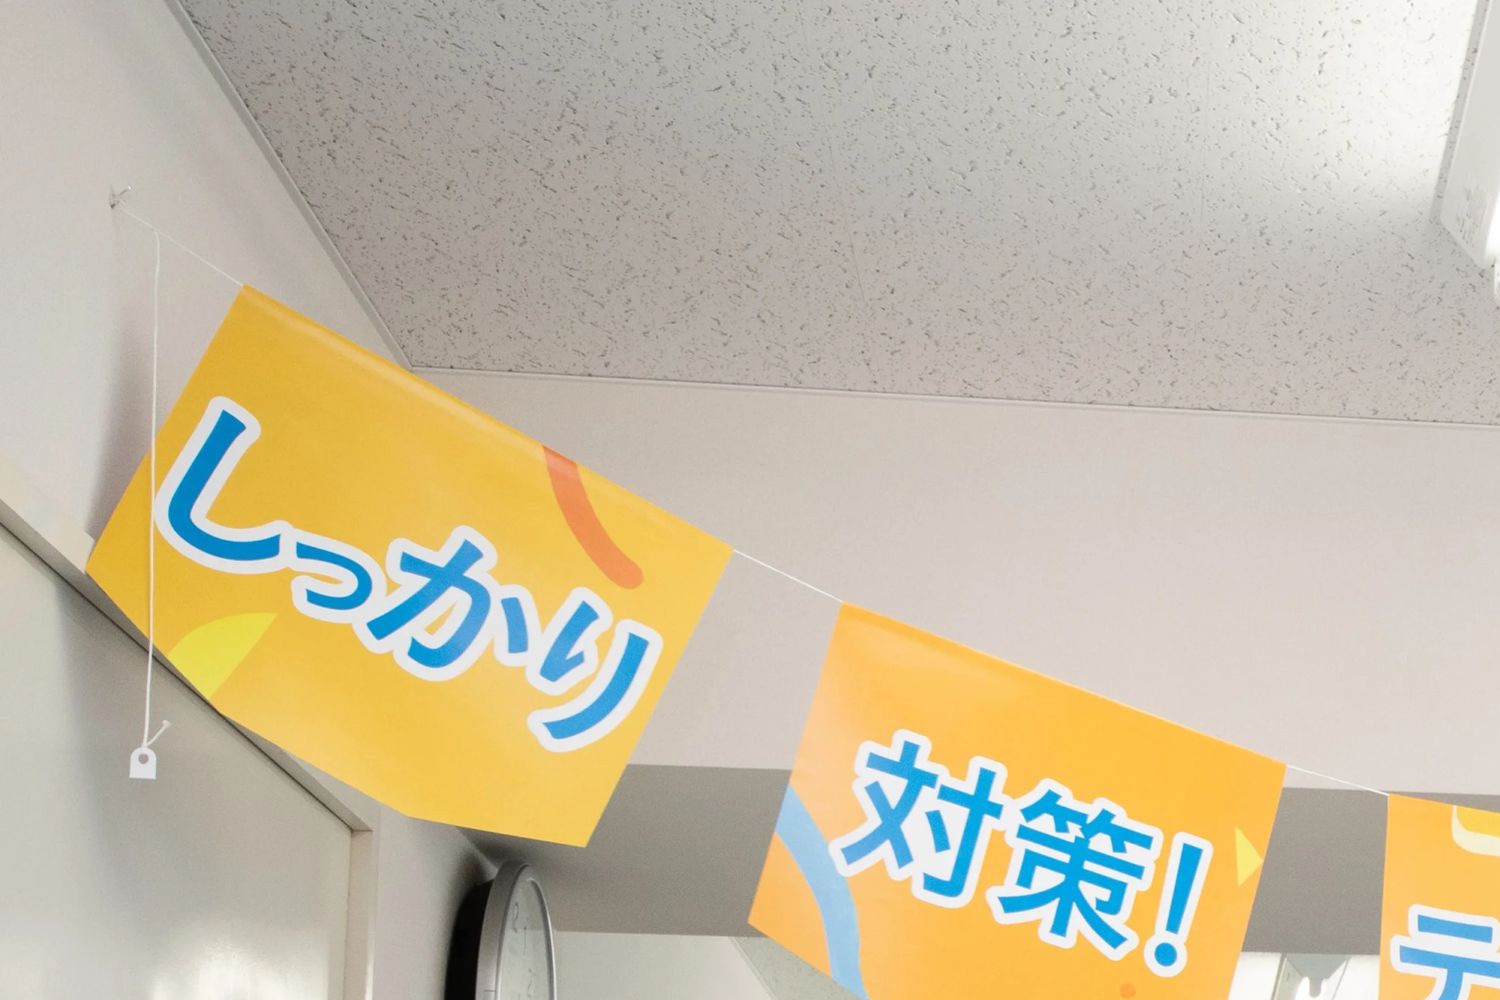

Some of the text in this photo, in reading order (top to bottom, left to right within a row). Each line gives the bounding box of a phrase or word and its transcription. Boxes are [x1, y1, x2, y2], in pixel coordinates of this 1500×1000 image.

[166, 408, 650, 741] しっかり
[839, 738, 1206, 968] 対策!
